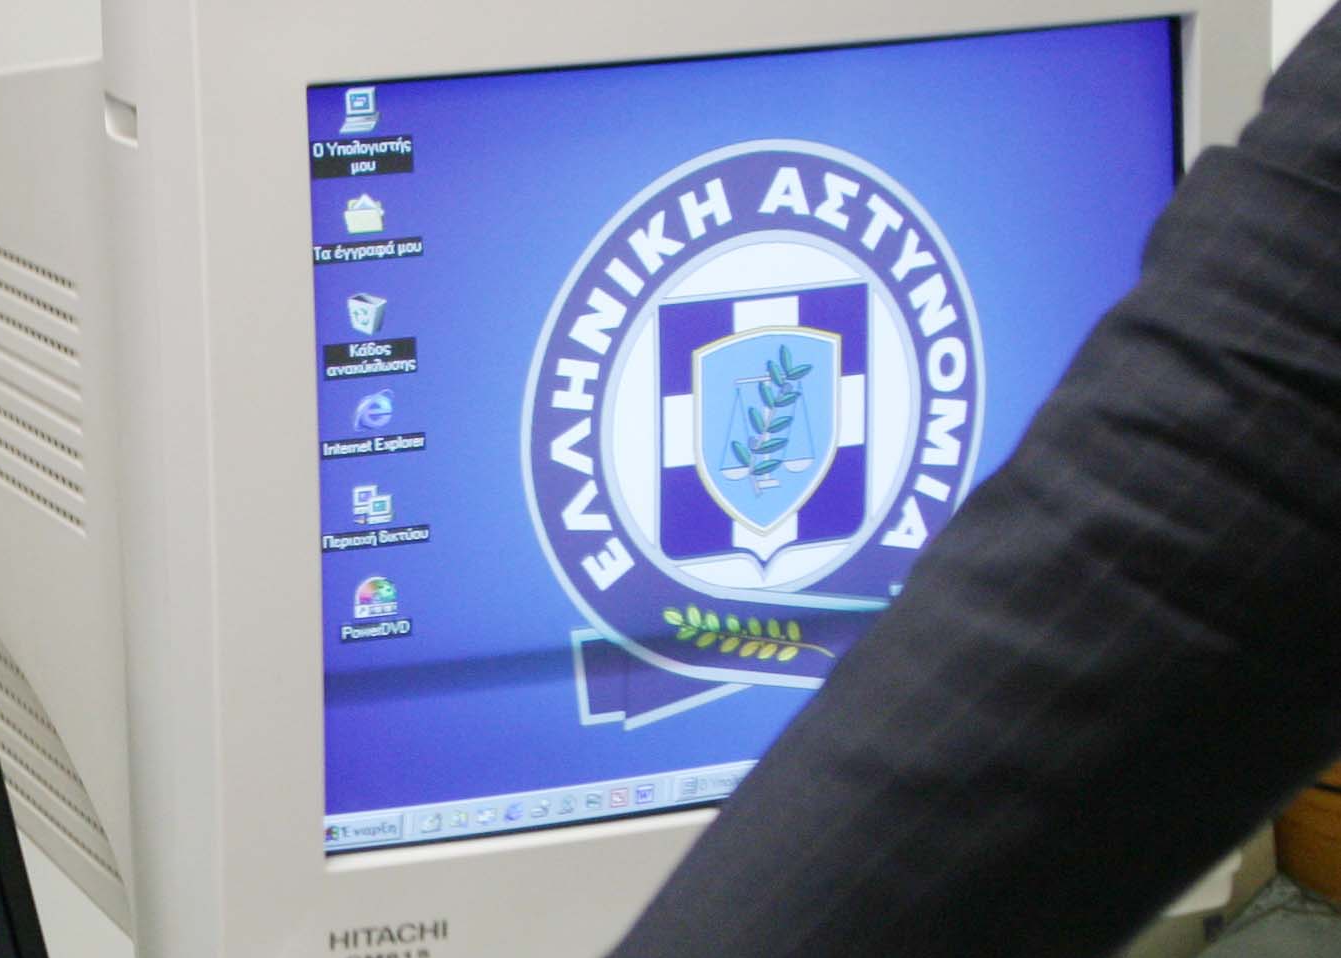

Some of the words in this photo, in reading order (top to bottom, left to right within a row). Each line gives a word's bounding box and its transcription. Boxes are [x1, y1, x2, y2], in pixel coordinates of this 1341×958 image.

[326, 137, 412, 156] Υπολογιστής
[351, 161, 376, 175] μου
[314, 246, 332, 260] Τα
[334, 240, 395, 261] έγγραφά
[397, 241, 422, 256] μου
[349, 342, 392, 357] Κάδος
[325, 359, 417, 377] ανακύκλωσης
[550, 178, 734, 592] ΕΛΛΗΝΙΚΗ
[758, 166, 969, 551] ΑΣΤΥΝΟΜΙΑ
[322, 440, 373, 456] Internet
[374, 435, 425, 452] Explorer
[322, 532, 377, 549] Περιοχή
[379, 527, 429, 544] δικτύου
[341, 620, 411, 640] PowerDVD
[329, 918, 449, 951] HITACHI
